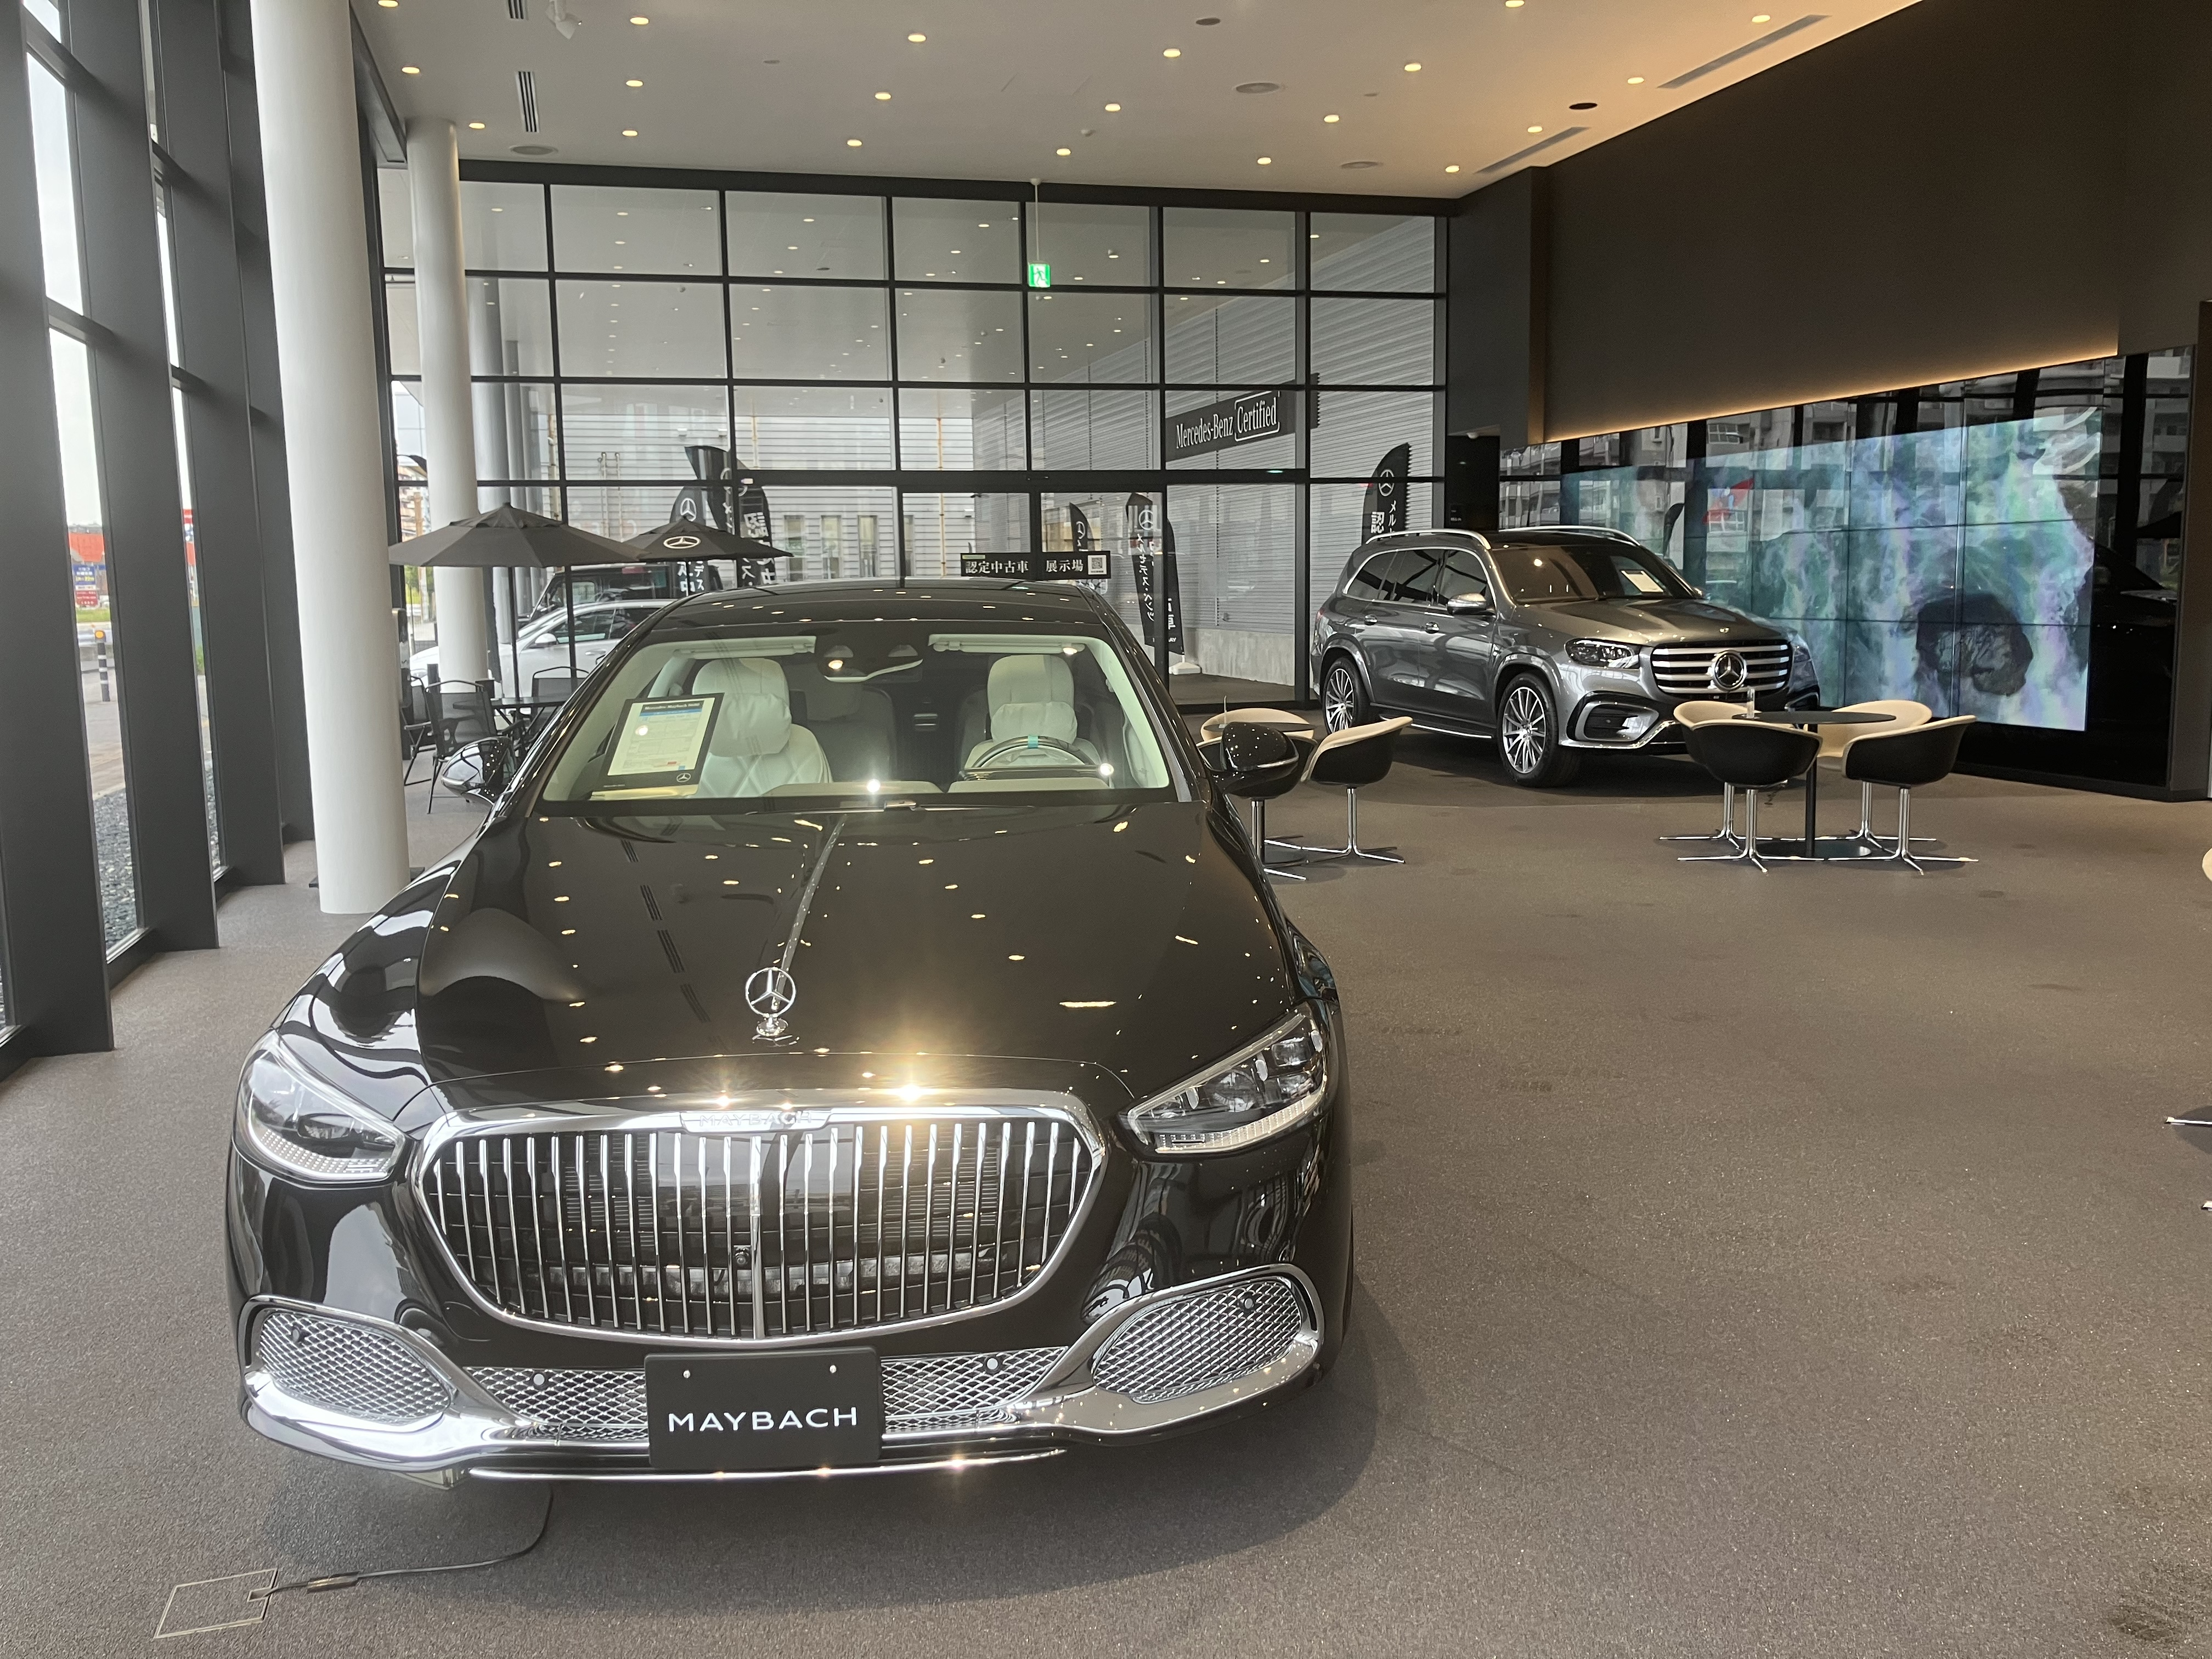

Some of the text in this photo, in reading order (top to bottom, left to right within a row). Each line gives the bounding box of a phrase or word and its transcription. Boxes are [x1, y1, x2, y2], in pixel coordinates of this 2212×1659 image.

[1176, 397, 1277, 449] Mercedes-Benz Certified
[965, 559, 1084, 574] 認定中古車 展示場
[699, 1110, 812, 1127] MAYBACH
[668, 1407, 858, 1432] MAYBACH
